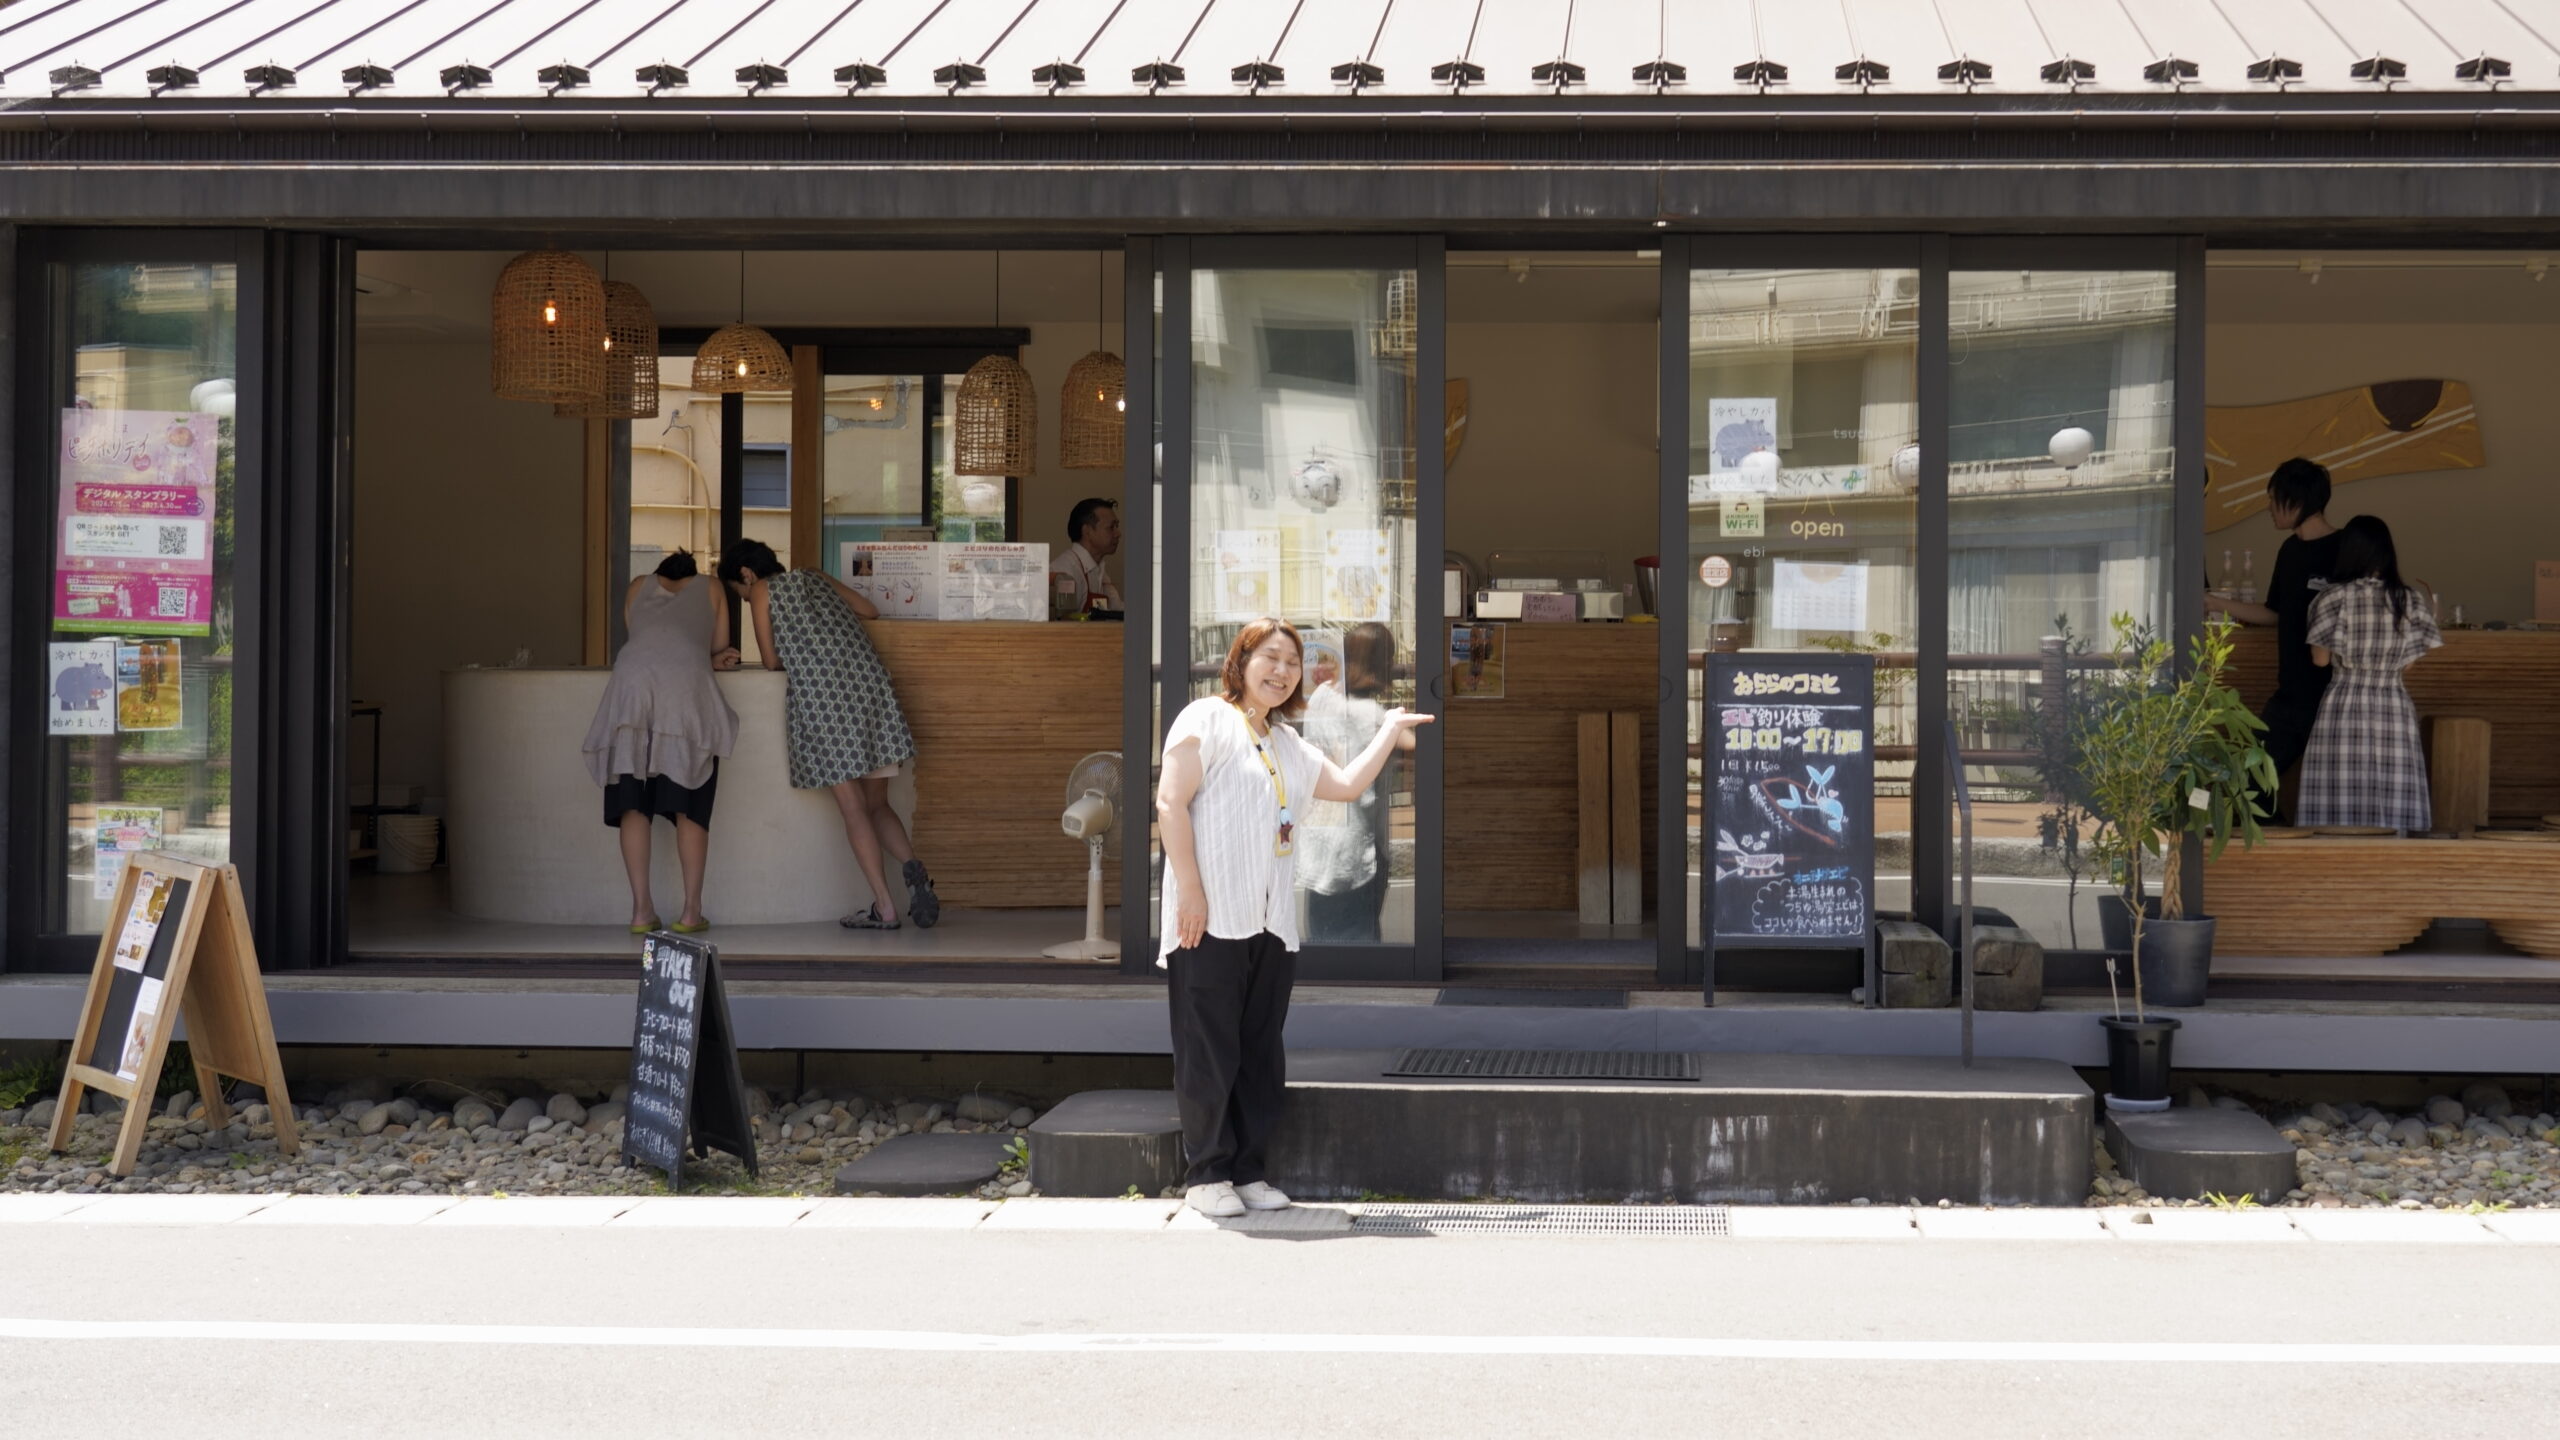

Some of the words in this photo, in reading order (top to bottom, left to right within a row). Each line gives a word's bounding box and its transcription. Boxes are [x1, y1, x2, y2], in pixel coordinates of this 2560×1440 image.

[1714, 406, 1773, 417] 冷やしカバ
[1726, 519, 1759, 529] Wi-Fi
[1791, 520, 1844, 540] open
[1743, 546, 1765, 558] ebi
[54, 650, 111, 660] 冷やしカバ
[52, 718, 109, 728] 始めました
[1721, 708, 1824, 728] エビ釣り体験
[657, 947, 694, 980] TAKE
[669, 981, 697, 1013] OUT
